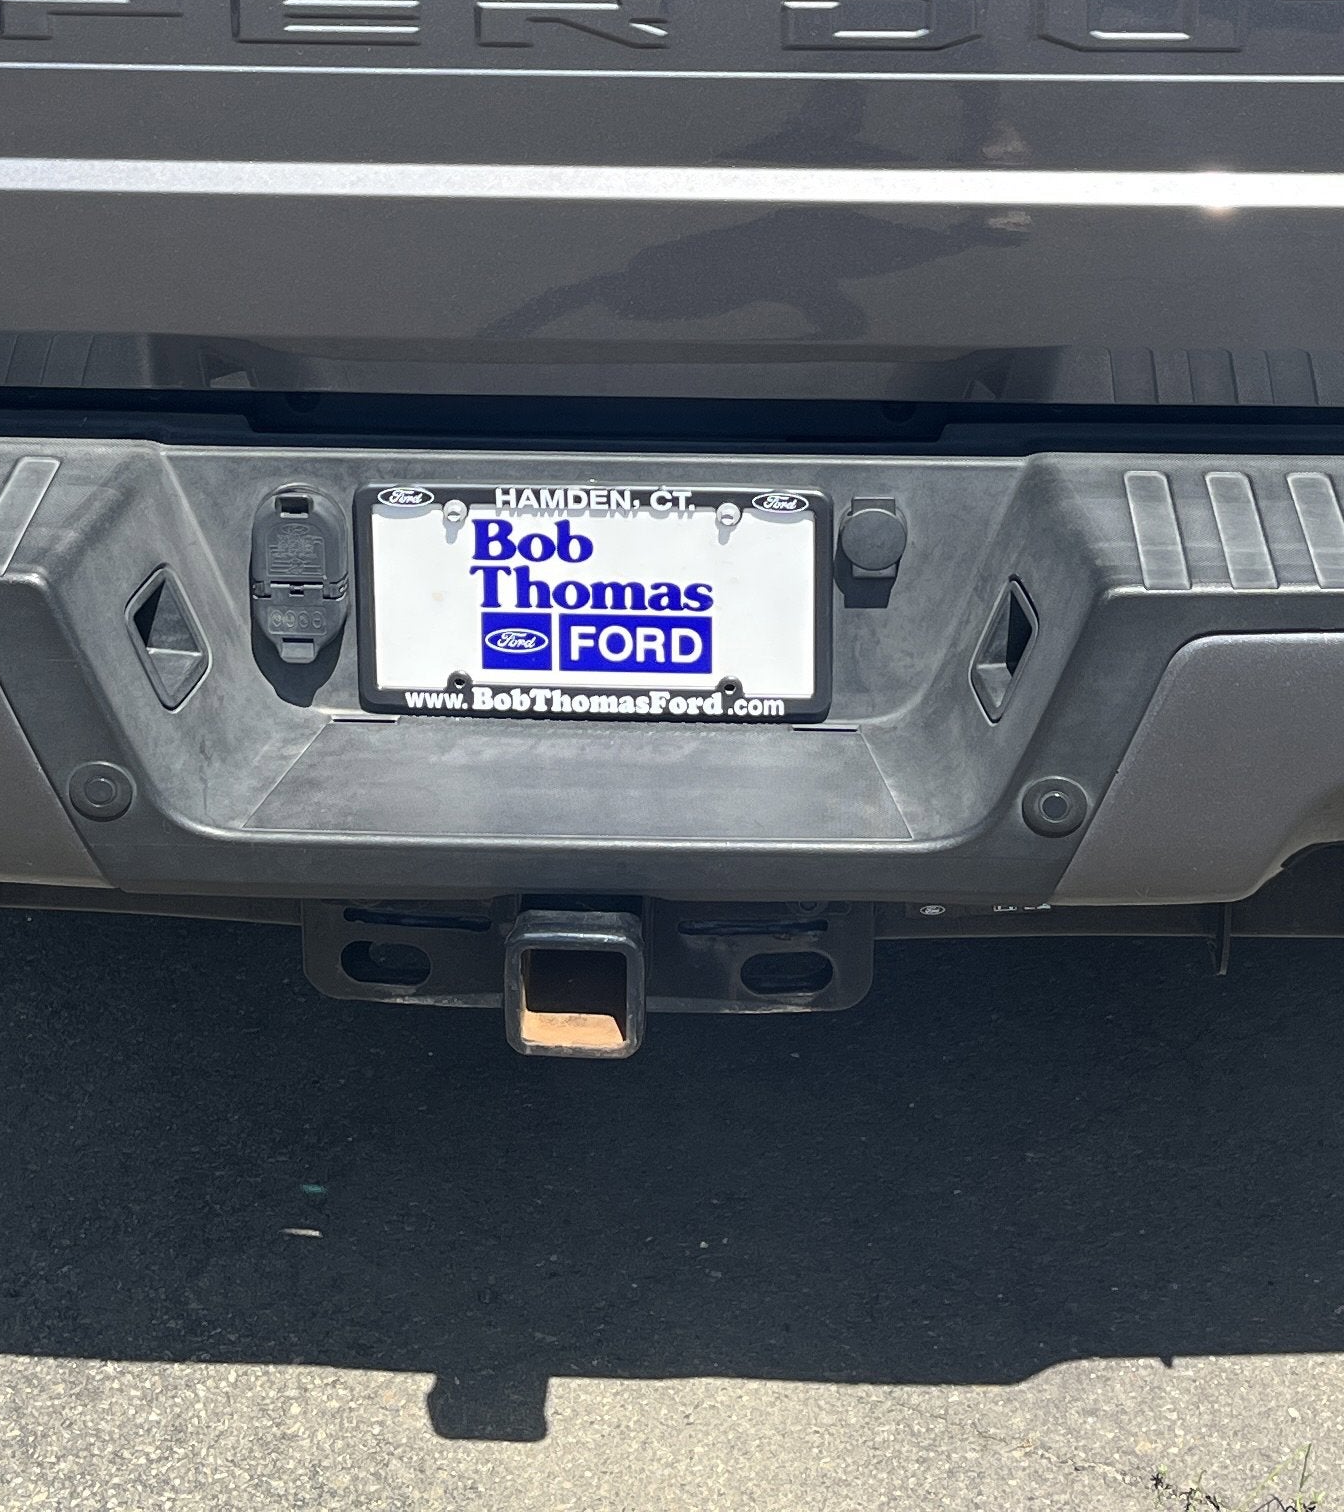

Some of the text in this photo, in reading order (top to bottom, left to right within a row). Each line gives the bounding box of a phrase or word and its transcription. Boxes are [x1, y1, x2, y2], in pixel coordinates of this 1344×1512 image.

[495, 488, 696, 511] HAMDEN, CT.
[472, 519, 594, 563] Bob
[470, 565, 714, 612] Thomas
[570, 625, 703, 663] FORD
[405, 687, 785, 717] www.BobThomasFord.com
